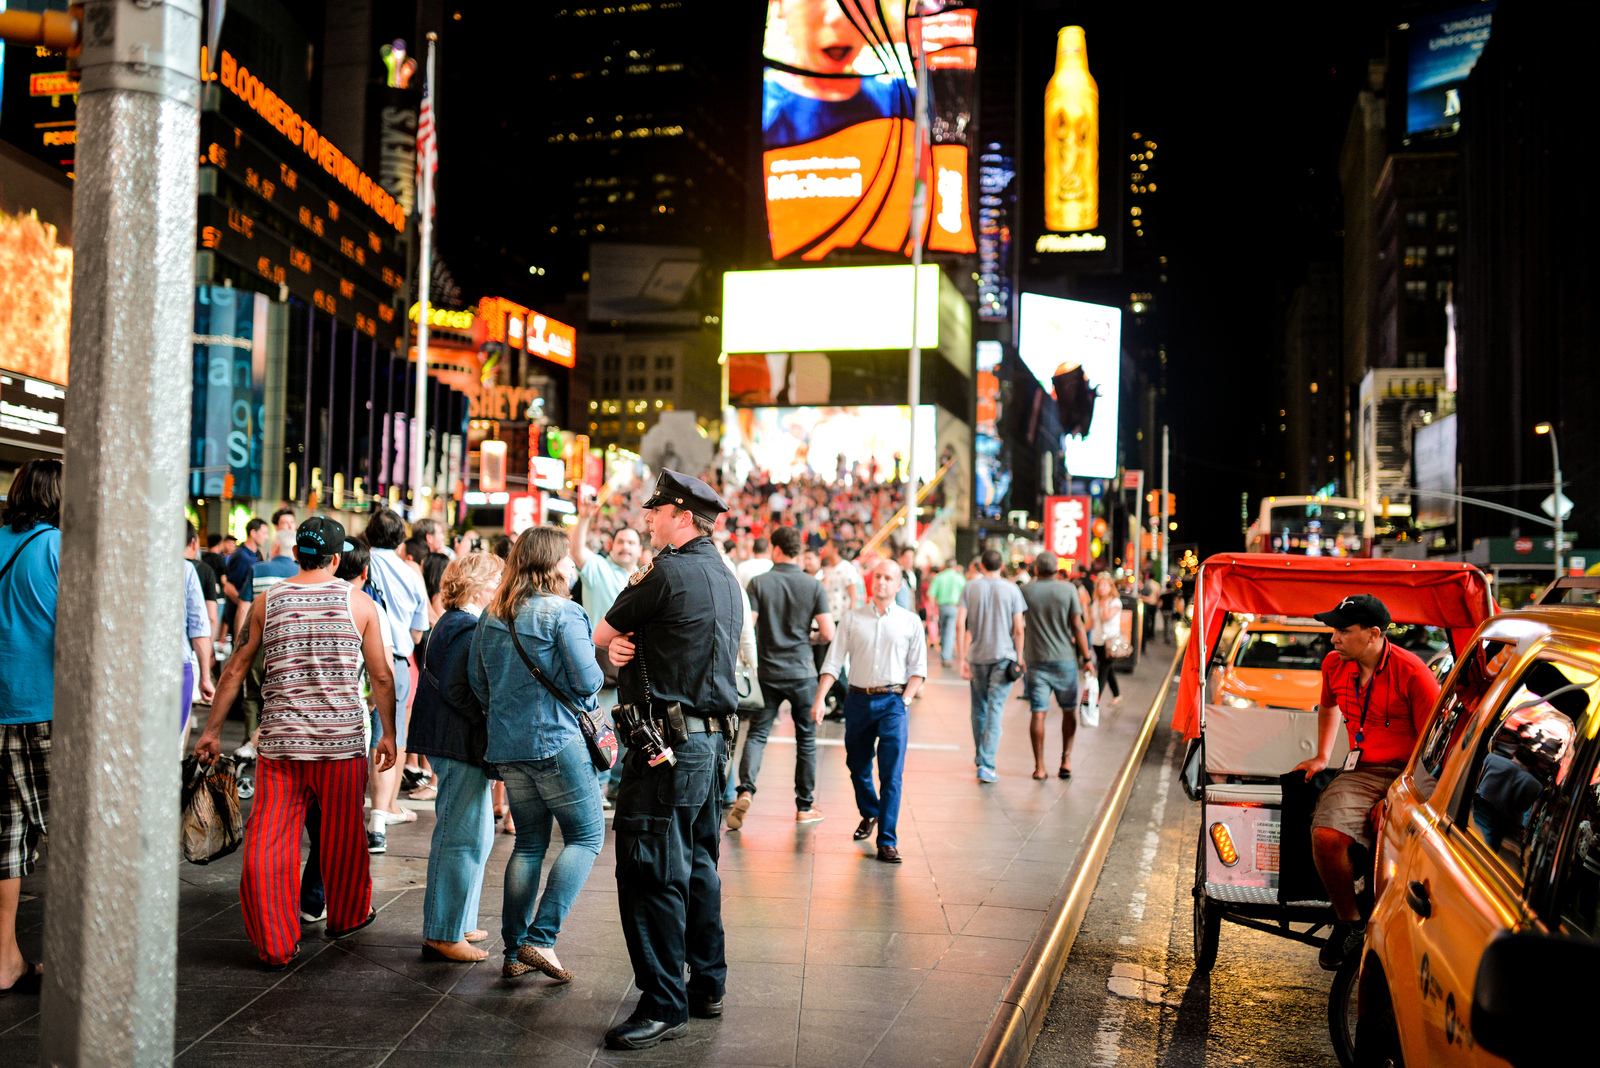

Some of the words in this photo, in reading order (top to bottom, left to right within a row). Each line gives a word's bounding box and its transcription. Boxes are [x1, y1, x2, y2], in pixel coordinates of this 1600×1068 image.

[220, 50, 303, 146] BLOOMBERG
[302, 120, 319, 160] TO
[318, 135, 360, 198] RETURN
